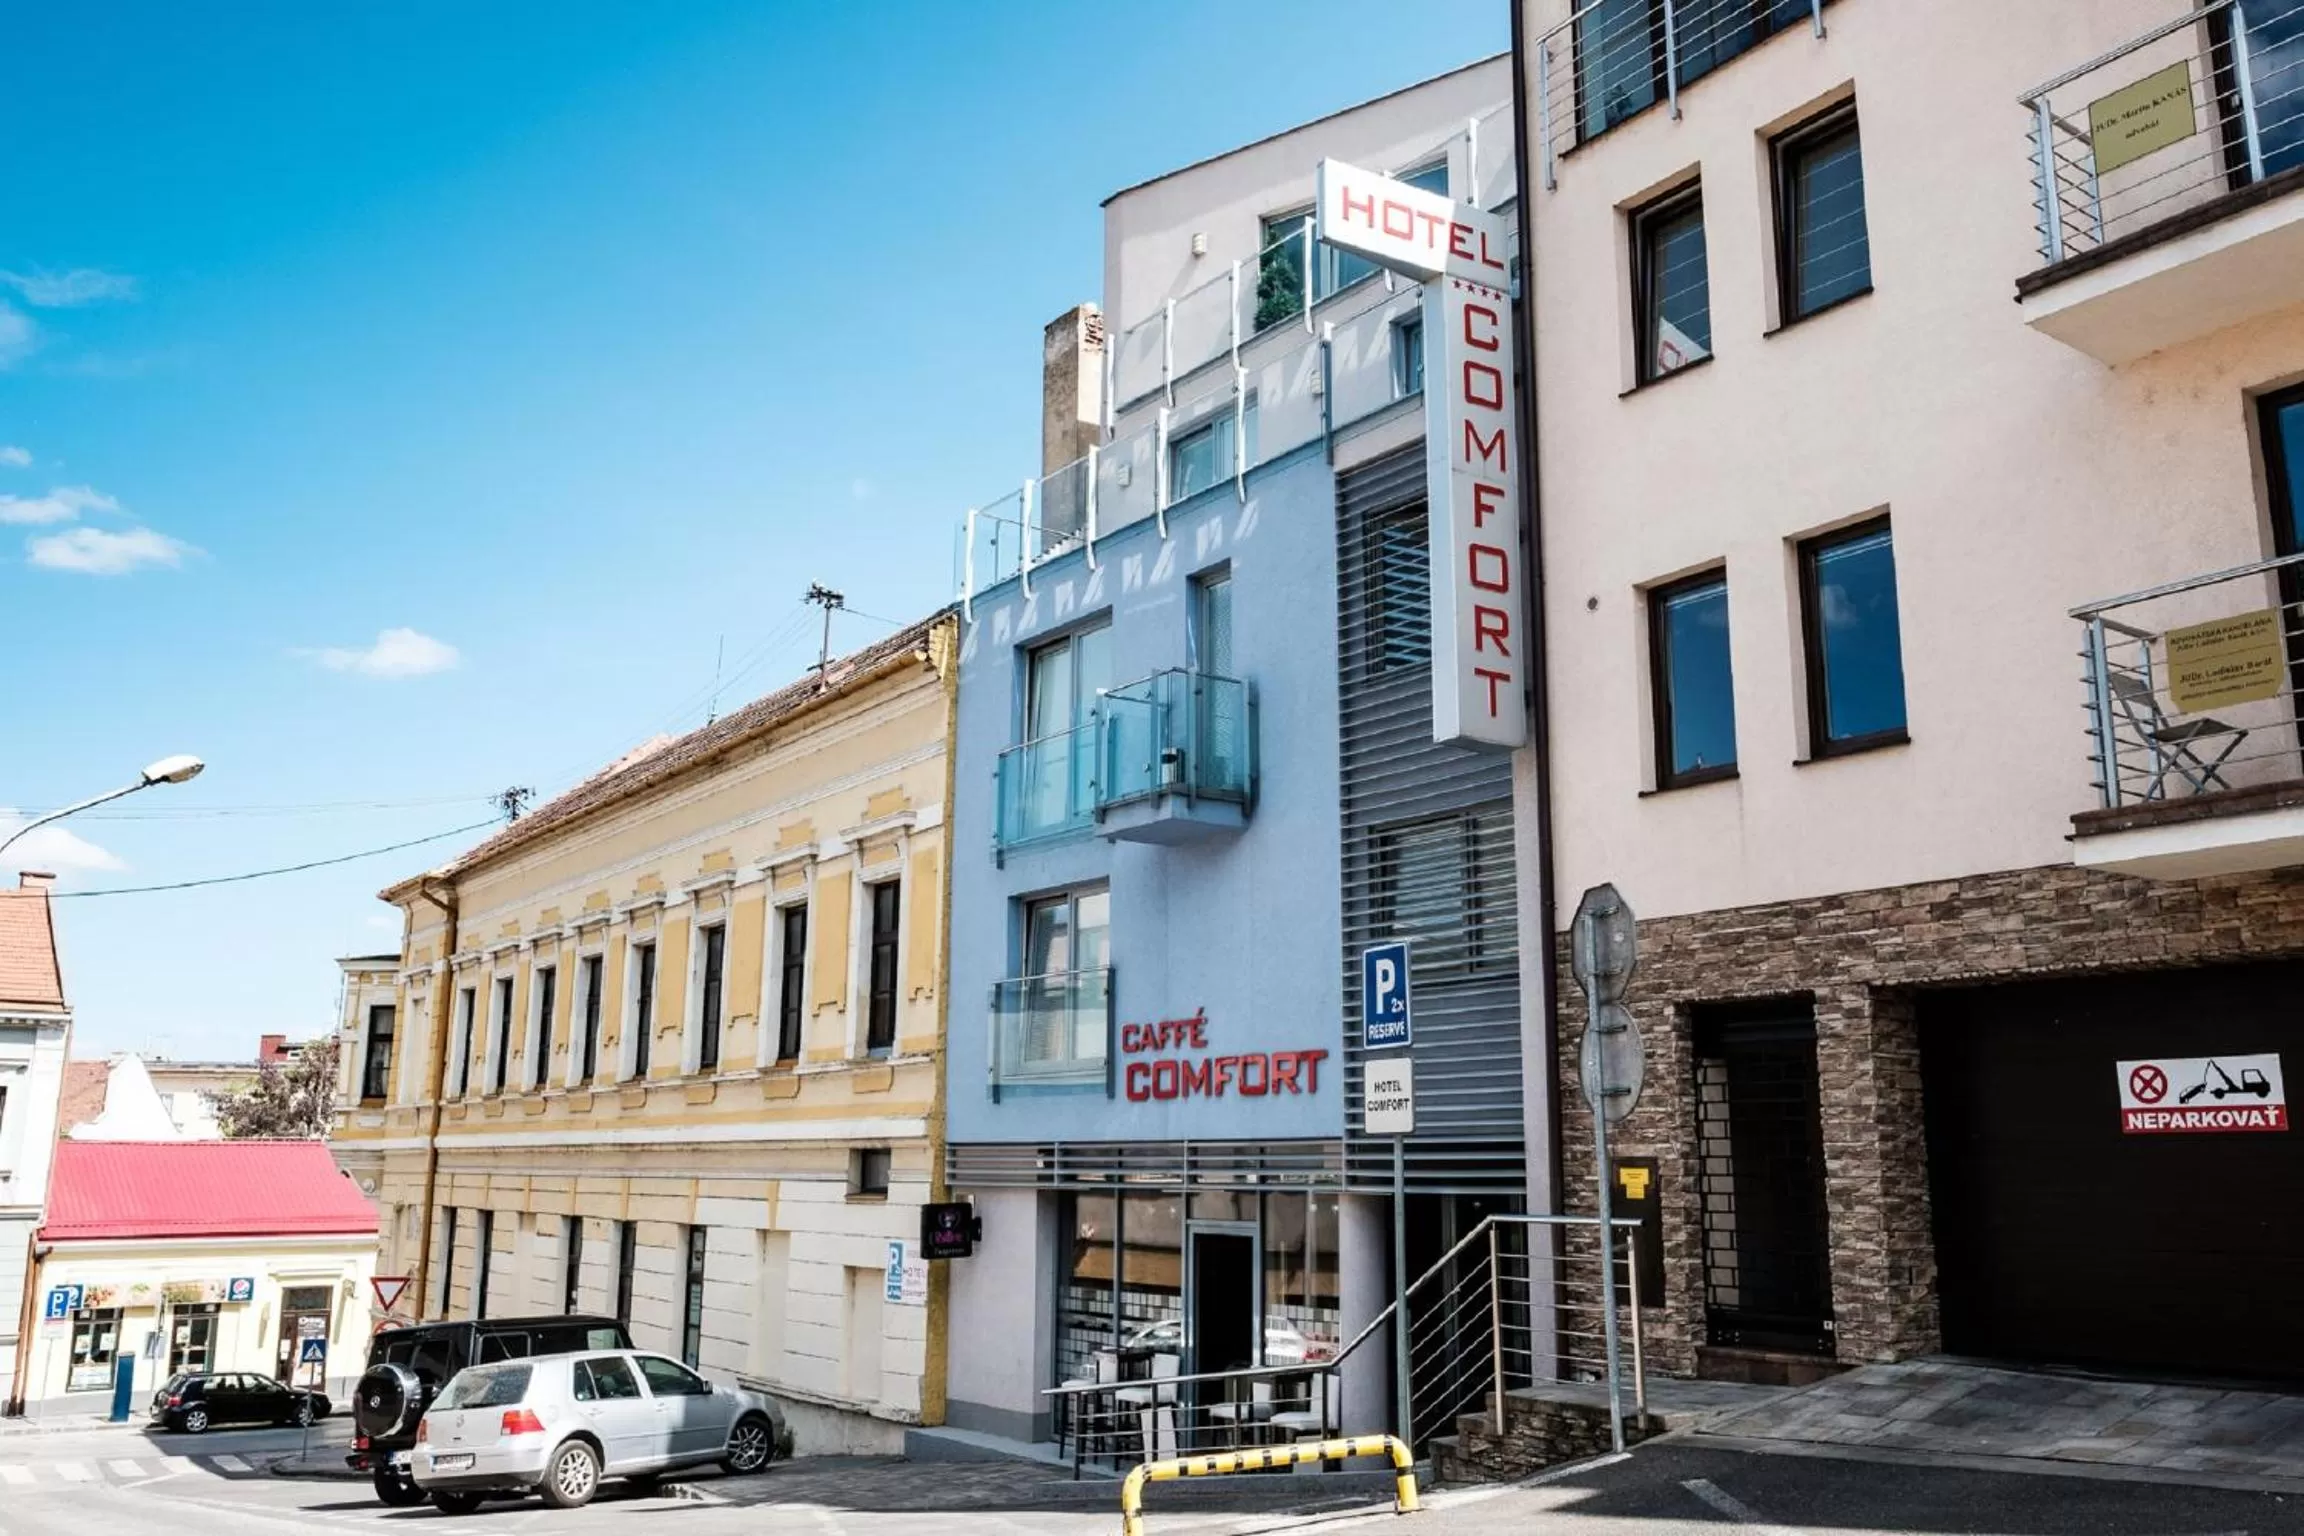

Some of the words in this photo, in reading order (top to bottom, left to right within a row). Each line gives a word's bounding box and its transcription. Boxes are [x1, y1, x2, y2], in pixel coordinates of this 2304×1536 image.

[2121, 104, 2151, 119] Martin
[1341, 185, 1505, 271] HOTEL
[1461, 303, 1512, 718] COMFORT
[1376, 958, 1395, 1015] P
[1390, 997, 1405, 1014] 2x
[1122, 1007, 1208, 1053] CAFFÉ
[1125, 1048, 1329, 1103] COMFORT
[1373, 1079, 1402, 1094] HOTEL
[1366, 1097, 1411, 1112] COMFORT
[2127, 1105, 2280, 1130] NEPARKOVAŤ
